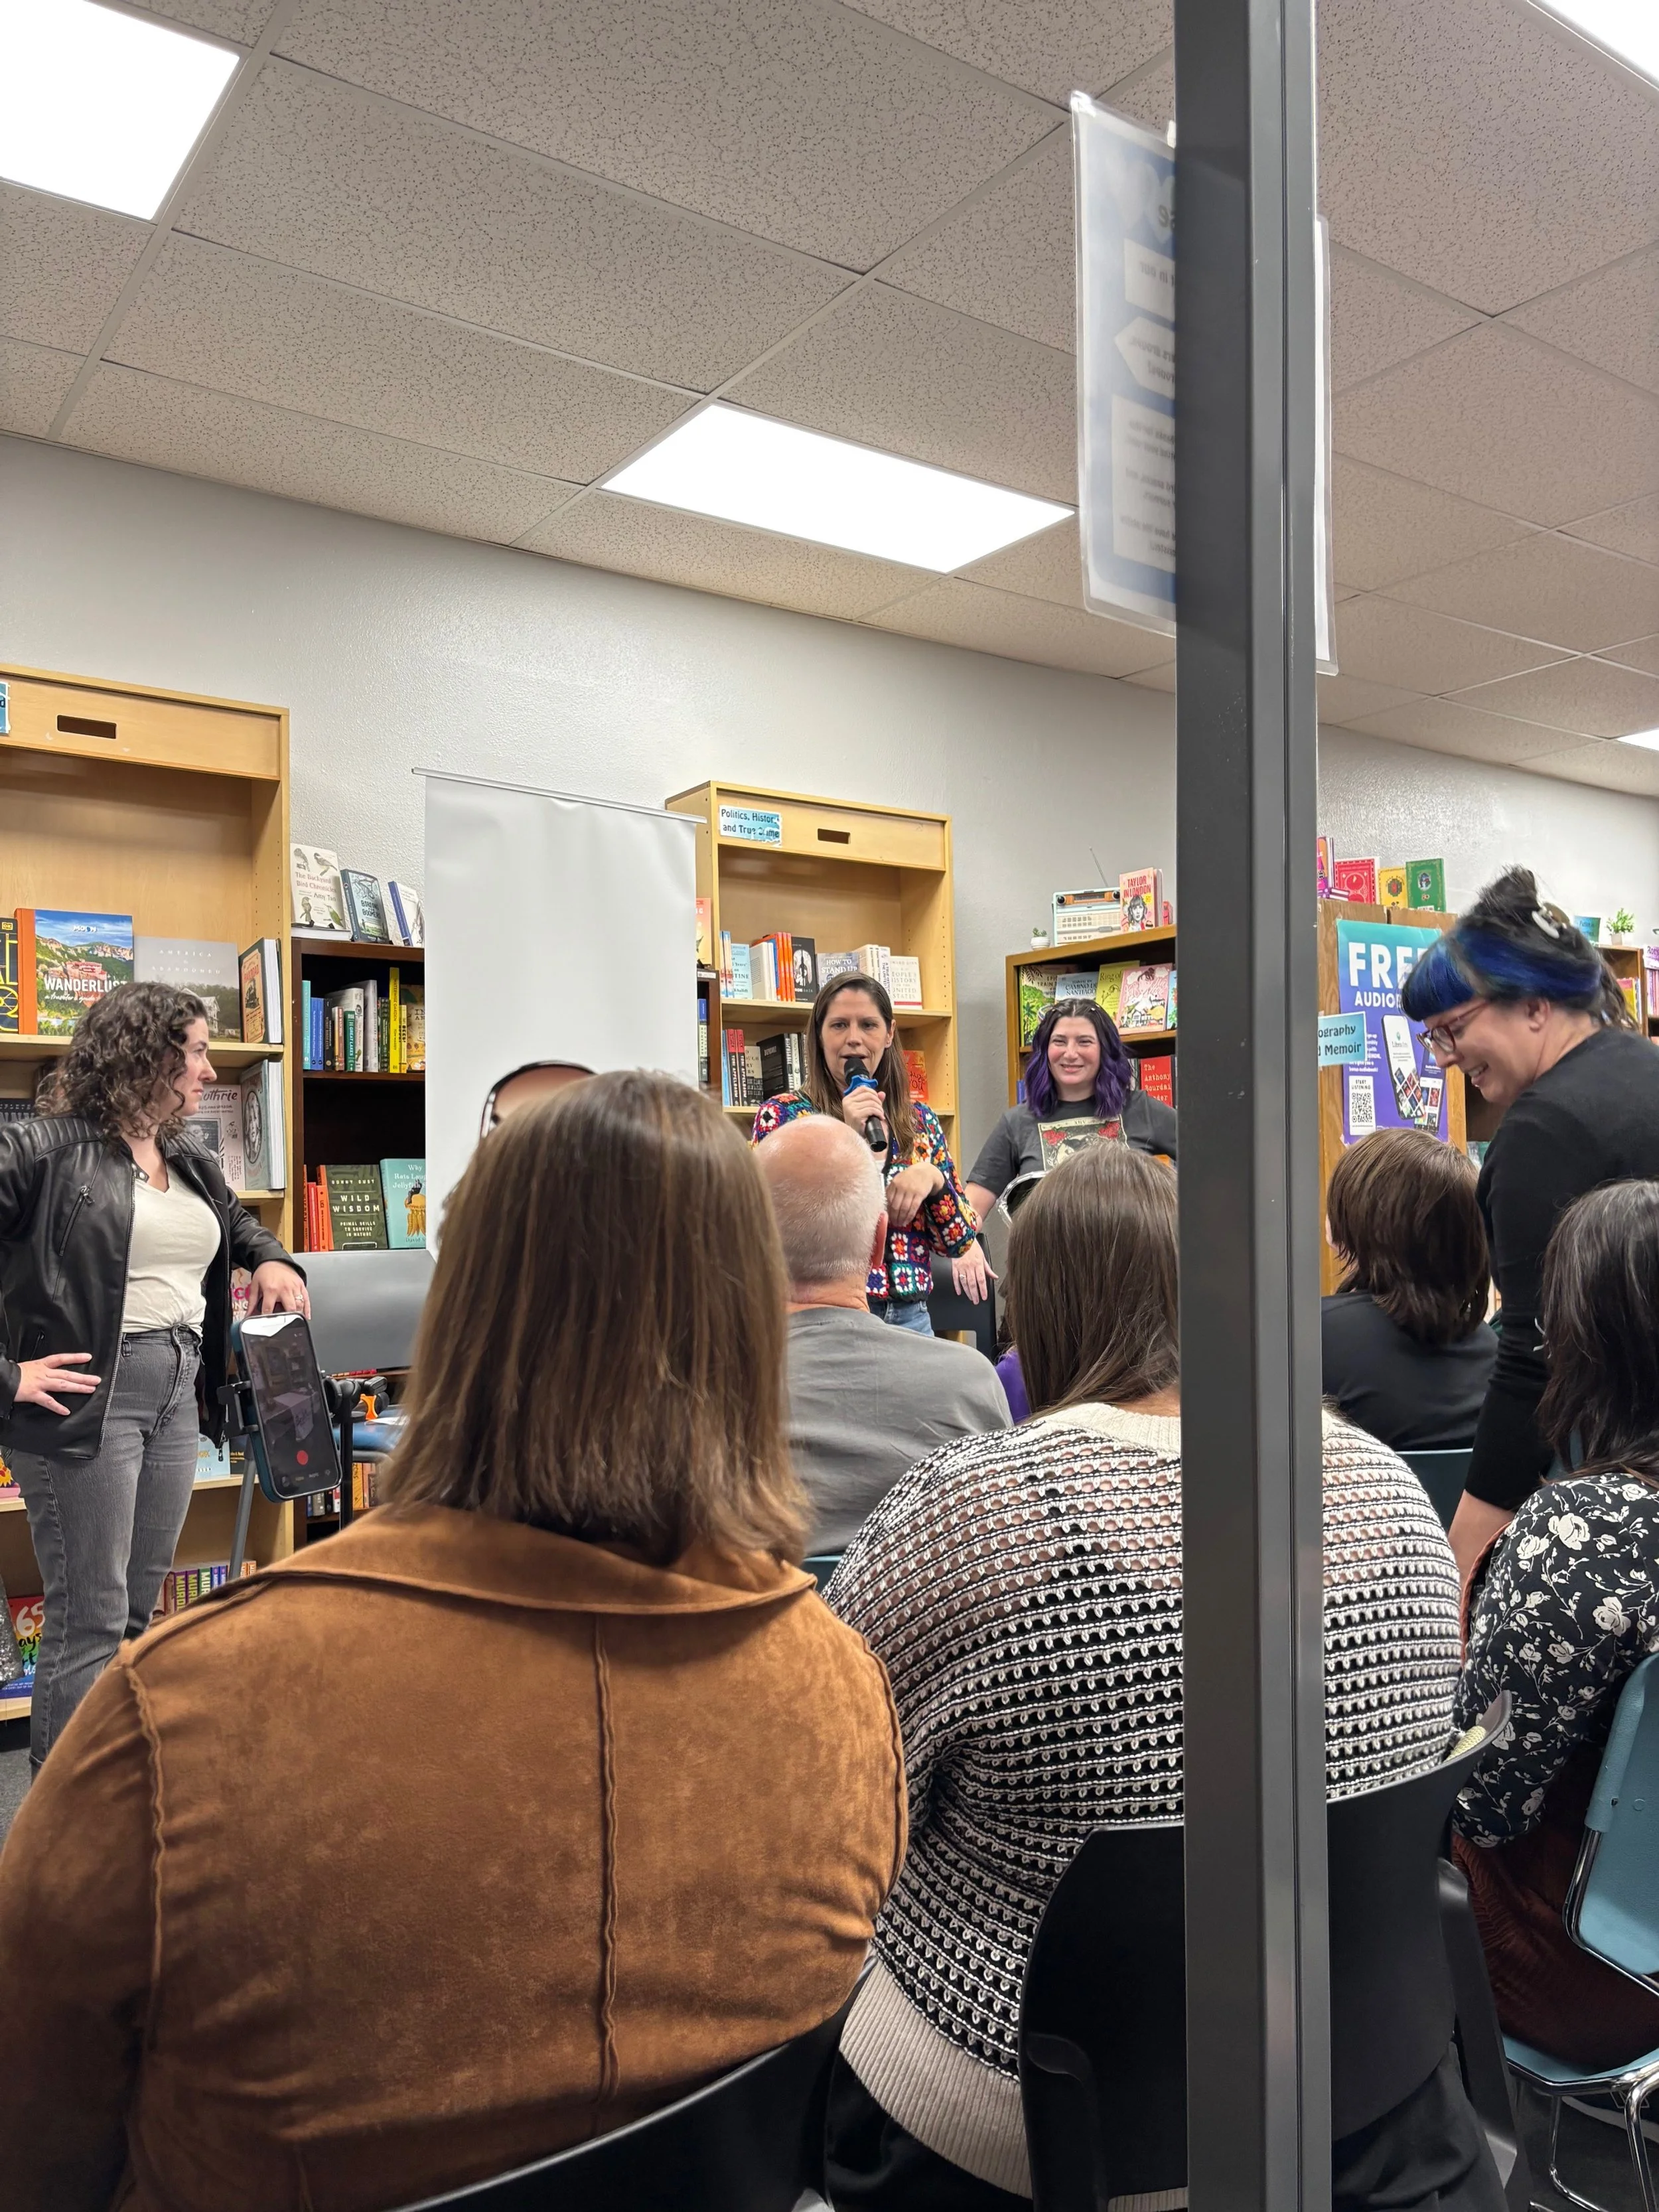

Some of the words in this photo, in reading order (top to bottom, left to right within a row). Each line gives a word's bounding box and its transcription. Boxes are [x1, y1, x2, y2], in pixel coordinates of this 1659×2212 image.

[752, 812, 780, 824] Histor
[723, 824, 737, 832] and
[307, 873, 331, 884] Backyard
[1127, 875, 1147, 888] TAYLOR
[310, 882, 336, 893] Chronicles
[1123, 889, 1129, 898] IN
[1129, 885, 1151, 897] LONDON
[313, 893, 326, 901] Amy
[1647, 945, 1659, 957] Rom
[151, 966, 221, 975] ABANDONED
[1348, 942, 1429, 990] FRE
[1100, 972, 1116, 982] Ring
[44, 978, 128, 994] WANDERLU
[1066, 988, 1096, 996] SANTIAGO
[1318, 1023, 1356, 1038] ography
[1325, 1042, 1362, 1056] Memoir
[1144, 1073, 1171, 1082] Anthony
[203, 1089, 238, 1101] uthrie
[332, 1205, 380, 1213] WISDOM
[15, 1600, 46, 1637] 65
[18, 1632, 42, 1653] ays
